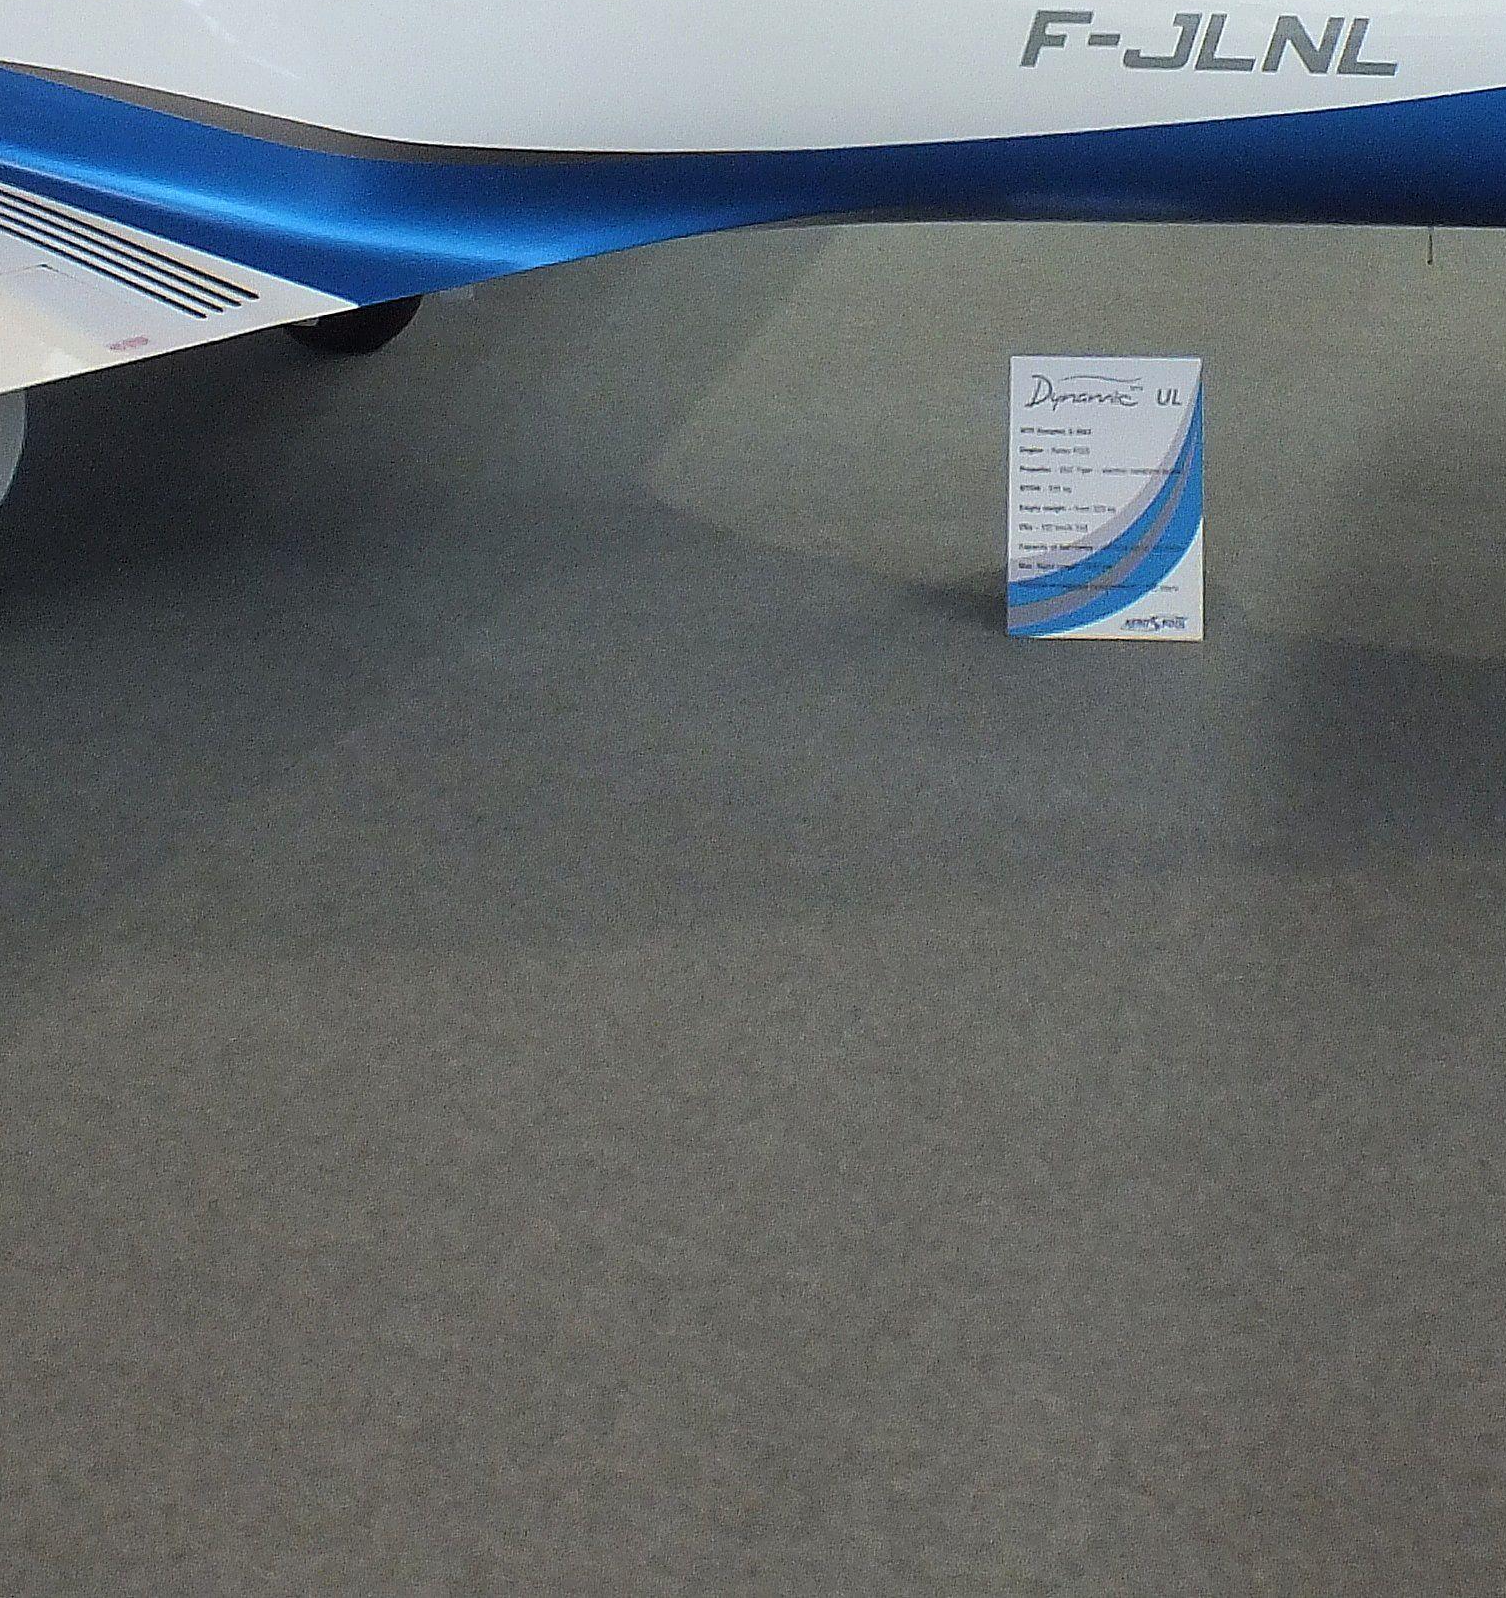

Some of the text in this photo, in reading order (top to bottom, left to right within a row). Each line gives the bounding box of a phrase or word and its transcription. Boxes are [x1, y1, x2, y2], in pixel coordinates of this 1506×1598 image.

[1019, 10, 1399, 78] F-JLNL
[1024, 374, 1182, 412] Dynamic UL
